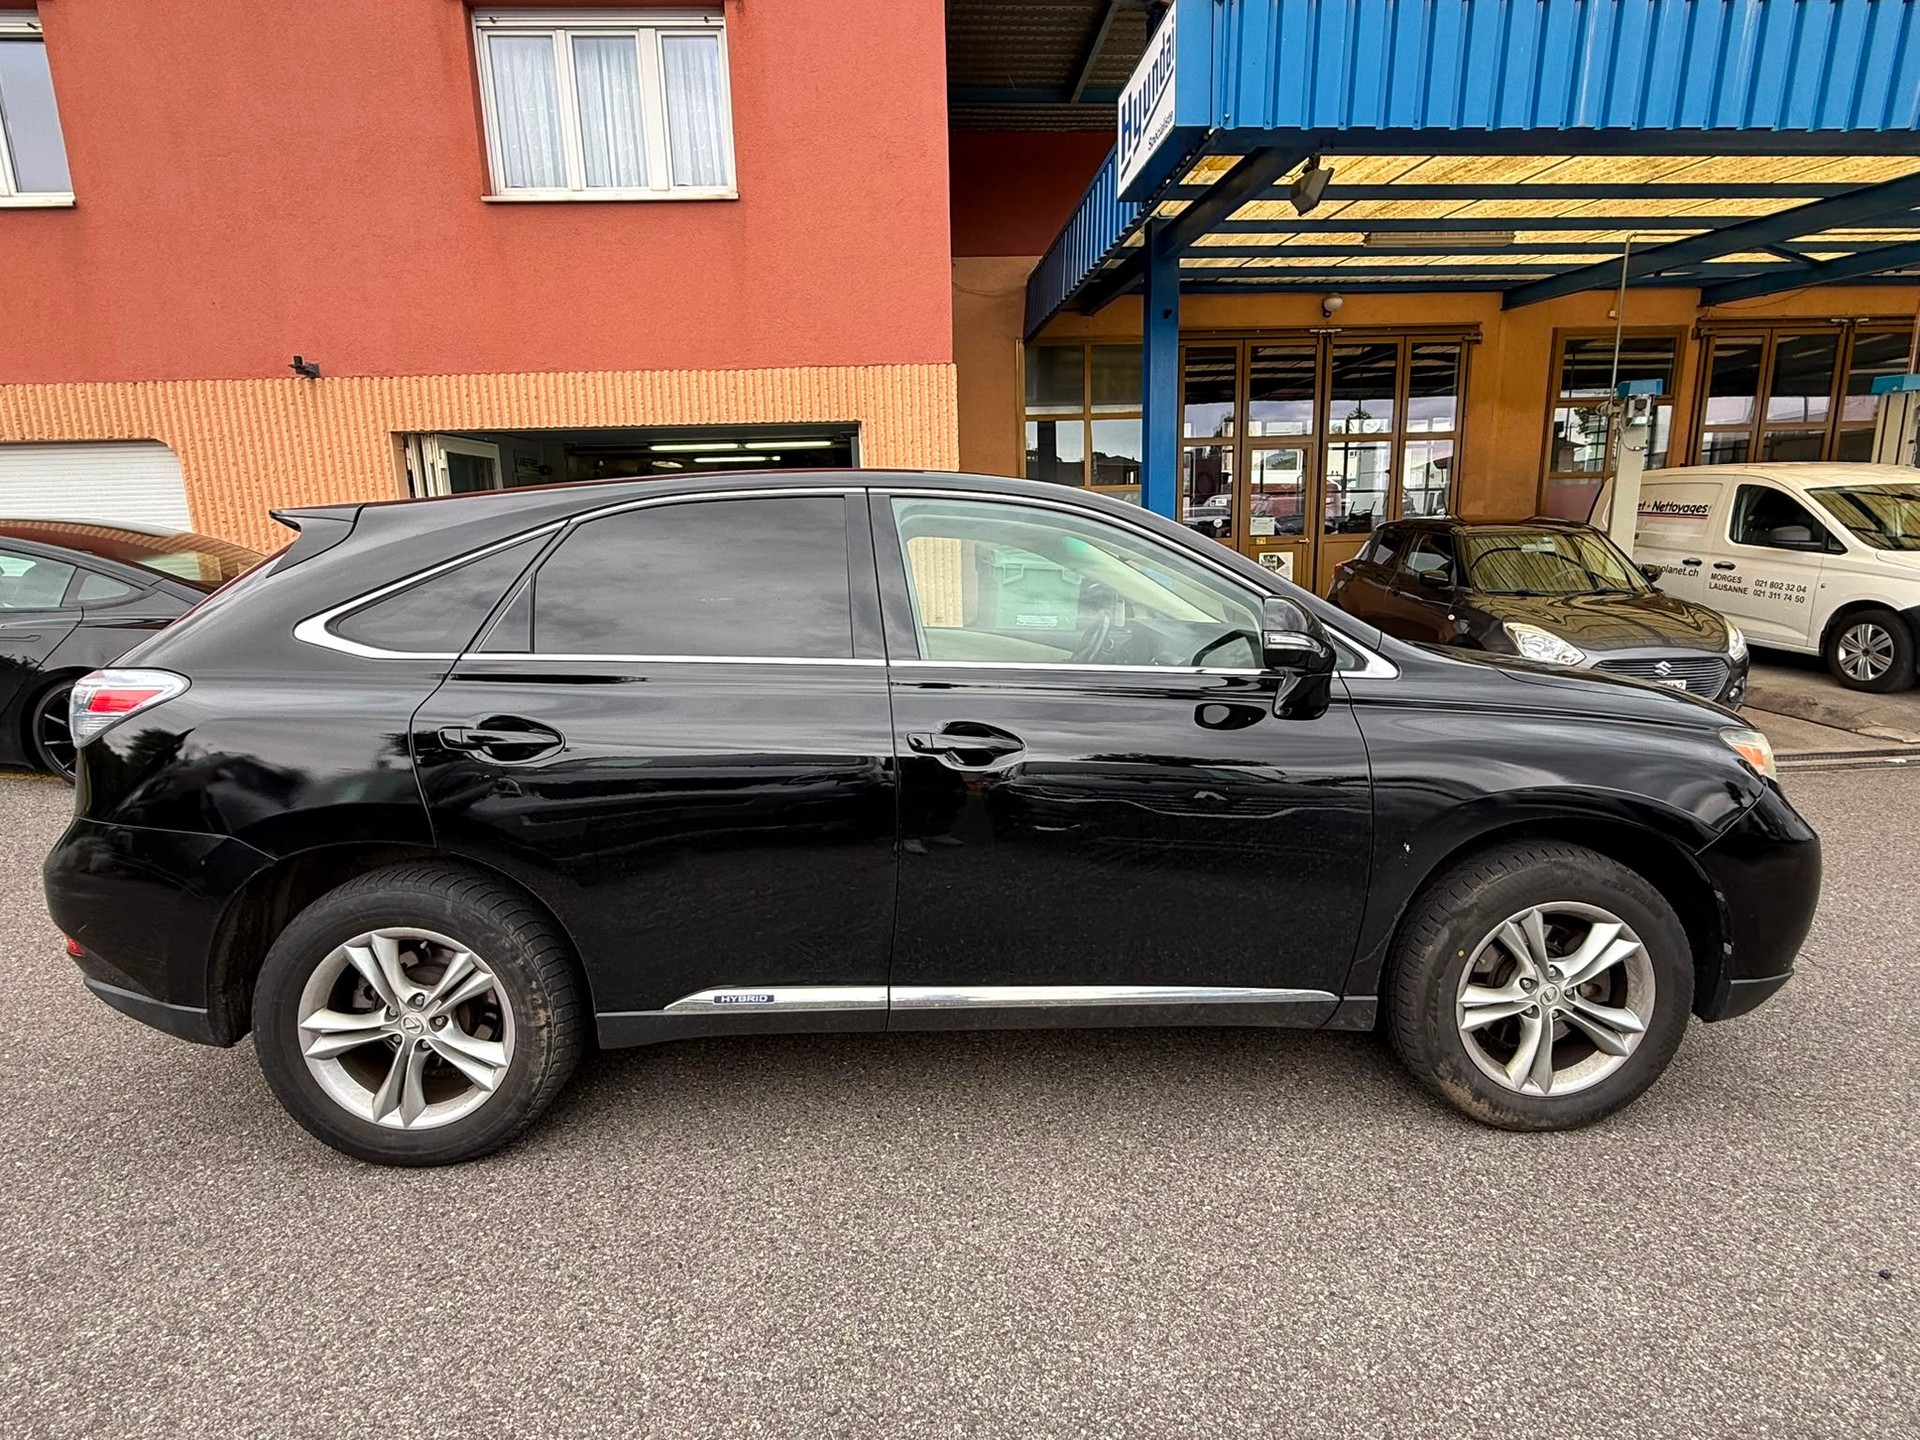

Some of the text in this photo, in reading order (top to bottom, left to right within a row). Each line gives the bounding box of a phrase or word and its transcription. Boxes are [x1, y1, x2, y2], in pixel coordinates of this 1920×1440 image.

[1121, 15, 1174, 165] Hyundai
[1652, 501, 1708, 515] Nettoyages
[1709, 582, 1805, 603] LAUSANNE 021 311 74 50
[1710, 573, 1807, 593] MORGES 021 802 32 04
[720, 995, 769, 1003] HYBRID
